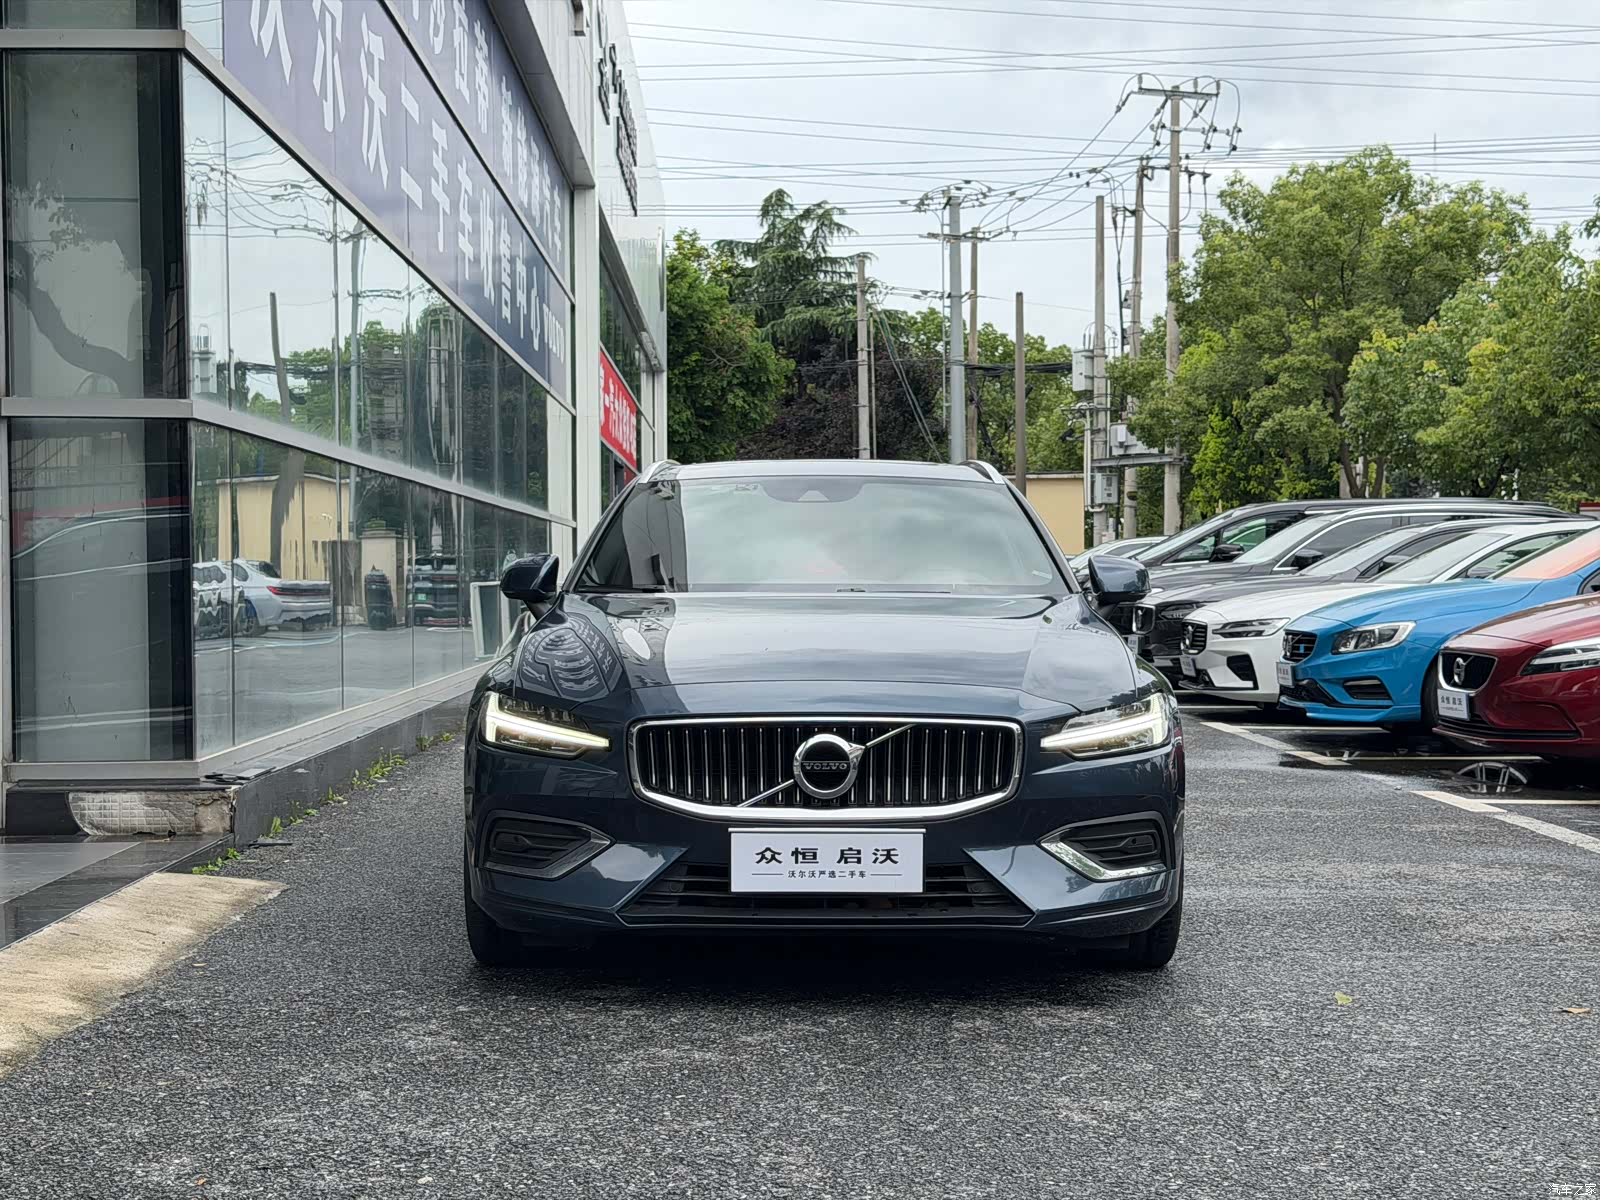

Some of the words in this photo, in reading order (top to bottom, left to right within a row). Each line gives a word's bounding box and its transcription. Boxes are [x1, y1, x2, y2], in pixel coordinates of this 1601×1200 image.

[803, 762, 848, 770] VOLVO
[787, 870, 867, 879] 沃尔沃严选二手车
